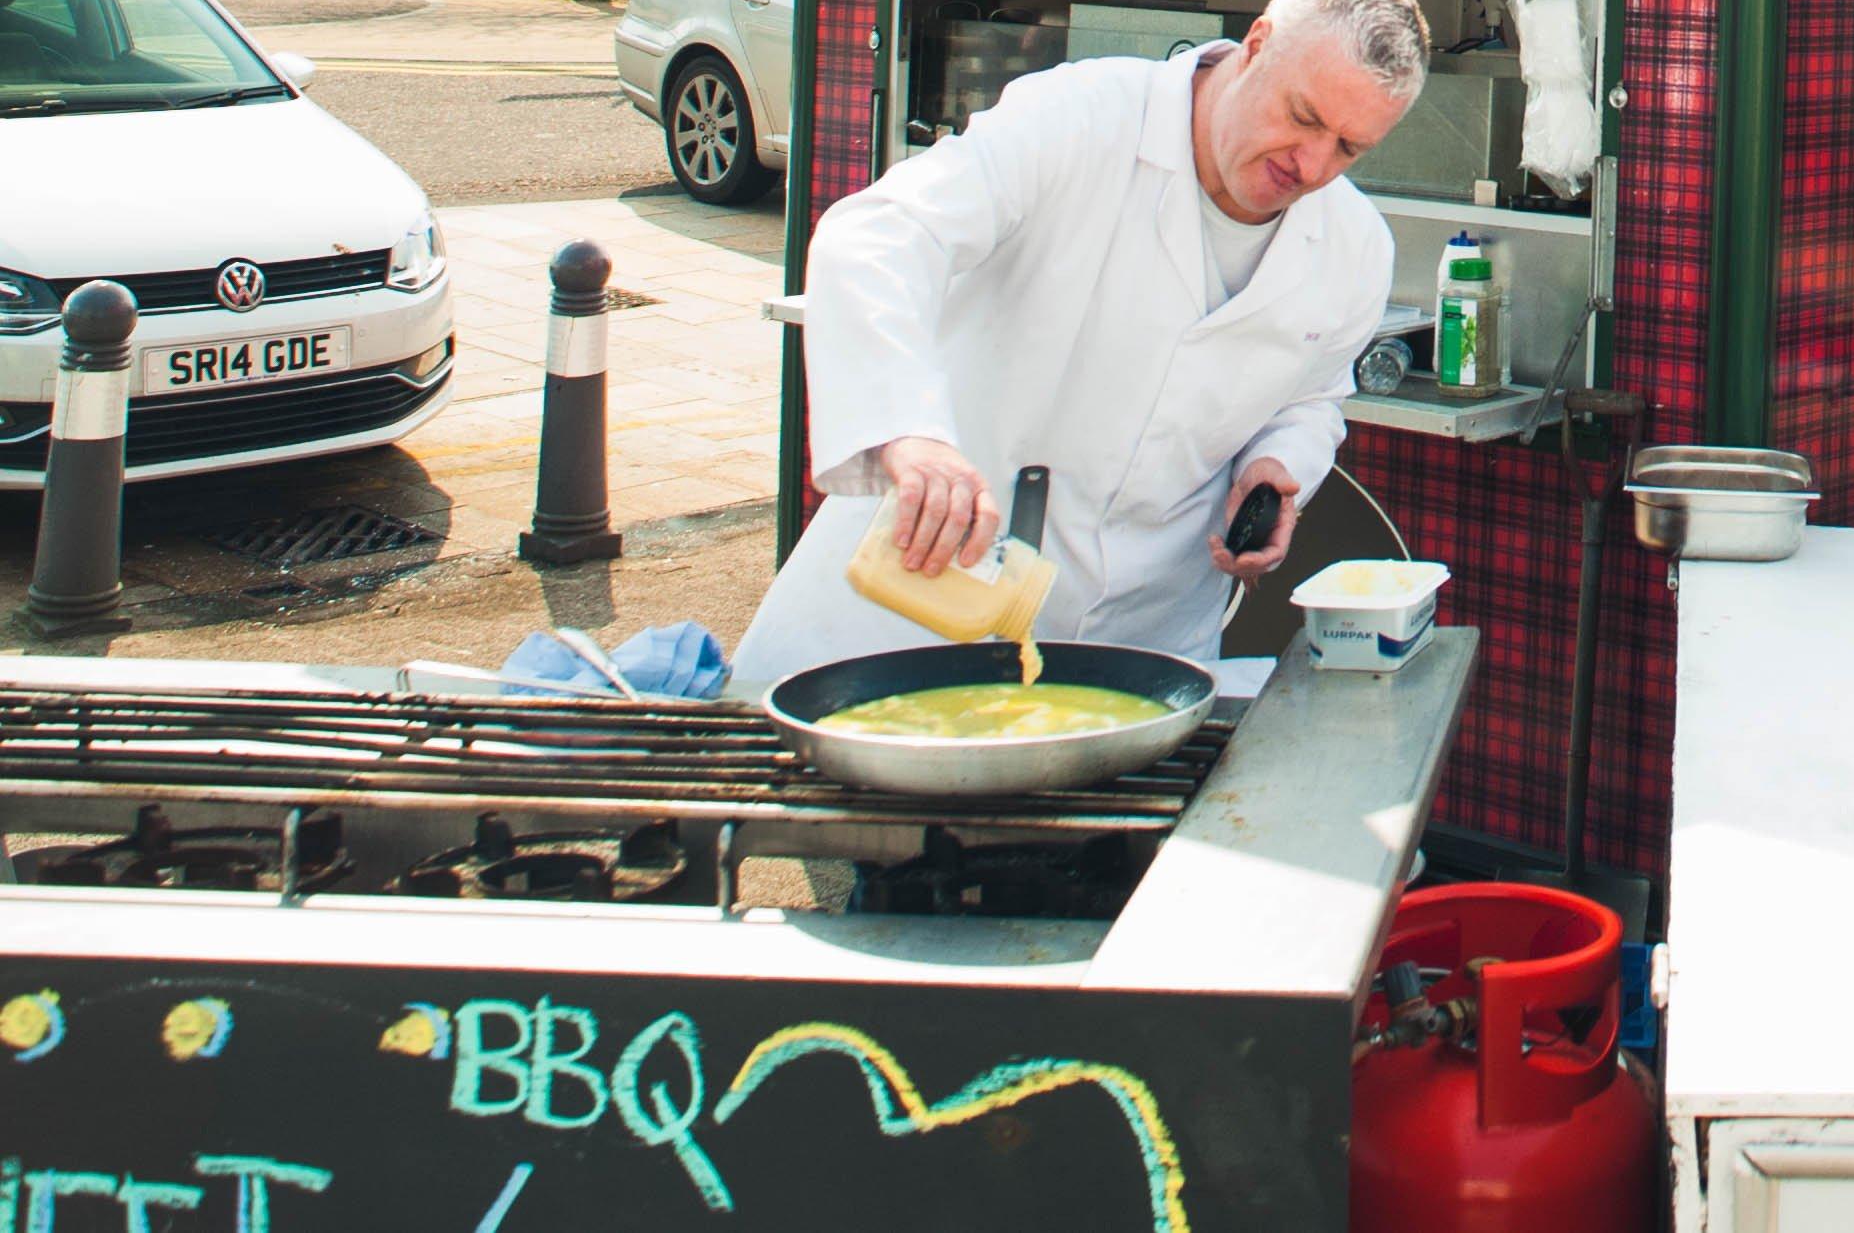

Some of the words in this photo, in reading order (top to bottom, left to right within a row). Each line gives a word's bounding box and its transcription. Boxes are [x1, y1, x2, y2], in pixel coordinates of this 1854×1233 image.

[169, 344, 252, 385] SR14
[263, 333, 331, 374] GDE
[1322, 629, 1374, 640] LURPAK
[449, 995, 731, 1210] BBQ
